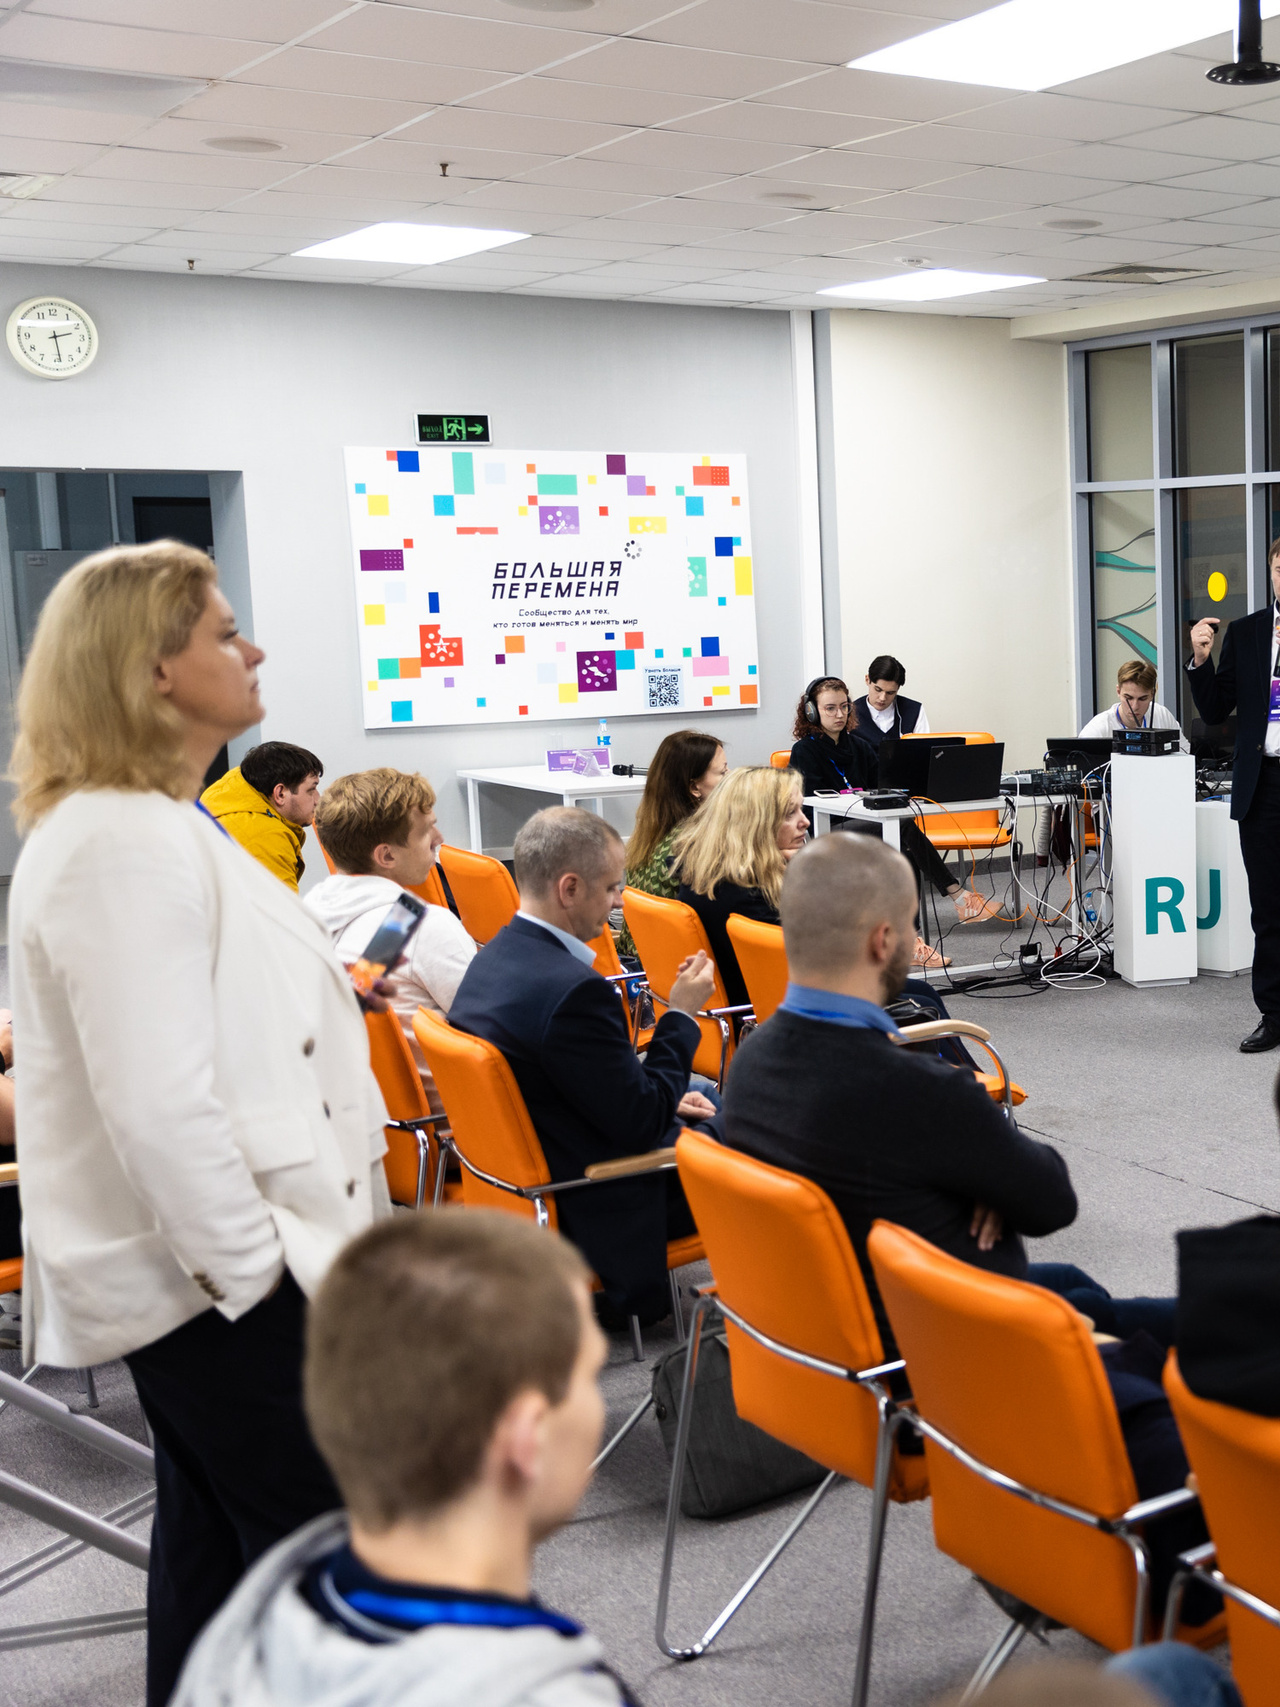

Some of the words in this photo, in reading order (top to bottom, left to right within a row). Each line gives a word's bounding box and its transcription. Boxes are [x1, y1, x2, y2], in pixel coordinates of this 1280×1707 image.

[37, 312, 45, 320] 11
[24, 332, 31, 340] 9
[494, 561, 622, 579] БОЛЬШАЯ
[492, 581, 619, 599] ПЕРЕМЕНА
[519, 608, 572, 618] Сообщество
[623, 619, 638, 627] мир
[1145, 876, 1187, 935] R
